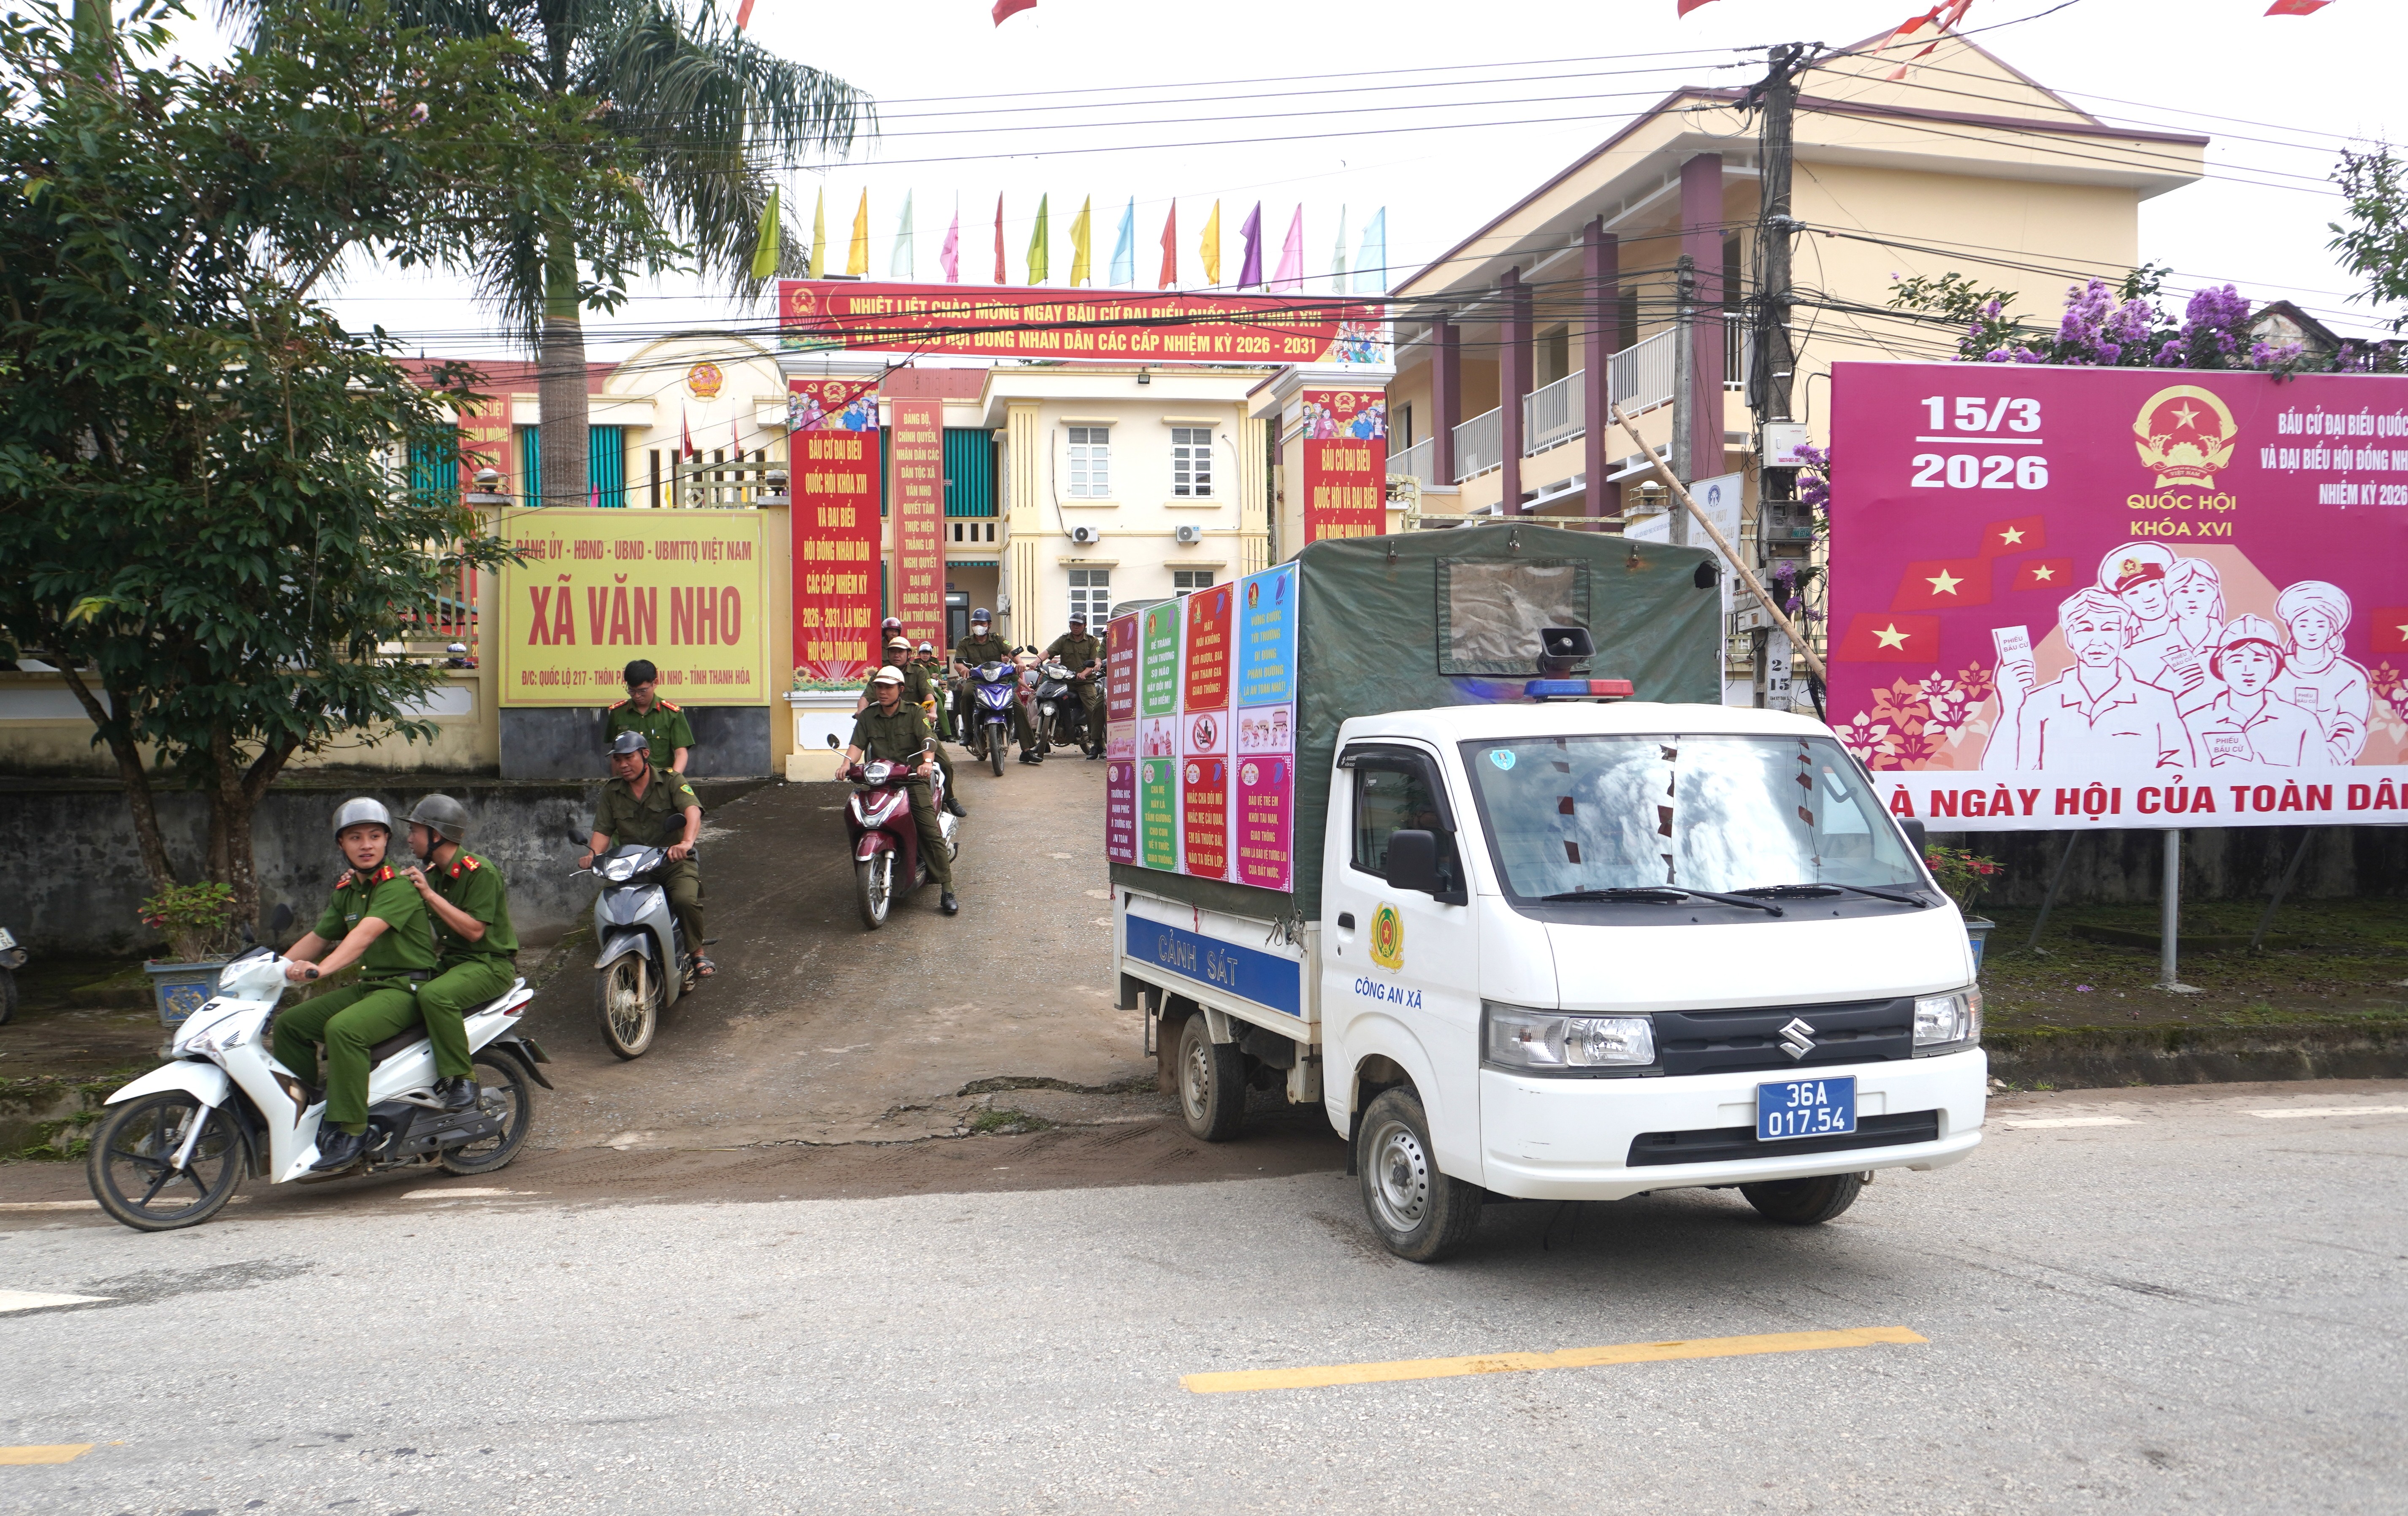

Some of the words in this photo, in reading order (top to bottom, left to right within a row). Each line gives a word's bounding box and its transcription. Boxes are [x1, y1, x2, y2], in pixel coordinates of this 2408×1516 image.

[932, 298, 971, 318] CHÀO
[976, 299, 1019, 320] MỪNG
[1019, 329, 1059, 349] NHÂN
[1065, 330, 1094, 350] DÂN
[1098, 331, 1127, 351] CÁC
[1131, 329, 1159, 352] CẤP
[1164, 332, 1210, 355] NHIỆM
[1215, 333, 1232, 353] KỲ
[1237, 336, 1270, 354] 2026
[1284, 337, 1316, 354] 2031
[904, 409, 920, 425] ĐẢNG
[1921, 396, 2042, 432] 15/3
[2278, 406, 2303, 434] BẦU
[2306, 404, 2325, 435] CỬ
[2324, 413, 2346, 440] ĐẠI
[2348, 406, 2375, 436] BIỂU
[2378, 408, 2408, 439] QUỐC
[486, 424, 508, 442] MỪNG
[898, 429, 916, 443] CHÍNH
[917, 427, 937, 444] QUYỀN,
[809, 432, 822, 459] BẦU
[824, 431, 834, 460] CỬ
[834, 439, 845, 464] ĐẠI
[847, 431, 862, 460] BIỂU
[1322, 441, 1334, 471] BẦU
[1335, 439, 1345, 471] CỬ
[1345, 449, 1355, 476] ĐẠI
[1357, 440, 1371, 472] BIỂU
[2261, 443, 2277, 469] VÀ
[2279, 448, 2300, 474] ĐẠI
[2302, 440, 2331, 470] BIỂU
[2333, 445, 2354, 475] HỘI
[2356, 442, 2389, 471] ĐỒNG
[805, 466, 823, 496] QUỐC
[824, 469, 836, 498] HỘI
[837, 469, 855, 494] KHÓA
[856, 474, 867, 494] XVI
[1911, 453, 2048, 490] 2026
[906, 483, 917, 496] VĂN
[919, 485, 931, 496] NHO
[1314, 478, 1330, 511] QUỐC
[1332, 482, 1342, 514] HỘI
[1343, 482, 1351, 509] VÀ
[1352, 486, 1362, 514] ĐẠI
[1364, 477, 1377, 509] BIỂU
[2127, 489, 2193, 510] QUỐC
[2199, 492, 2236, 513] HỘI
[2319, 480, 2359, 510] NHIỆM
[2361, 480, 2377, 505] KỲ
[2378, 484, 2408, 506] 2026
[818, 502, 826, 527] VÀ
[828, 507, 839, 532] ĐẠI
[840, 499, 856, 528] BIỂU
[2131, 516, 2192, 536] KHÓA
[2197, 522, 2232, 537] XVI
[516, 531, 546, 559] ĐẢNG
[549, 531, 563, 559] ỦY
[574, 540, 604, 559] HĐND
[615, 540, 644, 560] UBND
[655, 540, 698, 563] UBMTTQ
[701, 537, 724, 565] VIỆT
[727, 541, 752, 560] NAM
[804, 536, 815, 565] HỘI
[816, 534, 835, 561] ĐỒNG
[836, 537, 854, 561] NHÂN
[856, 537, 869, 561] DÂN
[807, 570, 820, 594] CÁC
[821, 567, 835, 594] CẤP
[836, 570, 857, 599] NHIỆM
[859, 570, 868, 594] KỲ
[910, 575, 919, 589] ĐẠI
[921, 573, 931, 588] HỘI
[528, 573, 576, 645] XÃ
[587, 573, 658, 645] VĂN
[670, 586, 742, 646] NHO
[803, 607, 819, 628] 2026
[825, 607, 843, 630] 2031,
[844, 603, 853, 628] LÀ
[853, 604, 871, 628] NGÀY
[1204, 619, 1214, 632] HÃY
[807, 637, 819, 666] HỘI
[820, 632, 834, 661] CỦA
[834, 637, 852, 661] TOÀN
[853, 637, 867, 661] DÂN
[1157, 637, 1171, 649] TRÁNH
[1205, 633, 1221, 645] KHÔNG
[2003, 635, 2023, 645] PHIẾU
[1214, 651, 1223, 662] BIA
[522, 670, 537, 686] Đ/C:
[539, 665, 560, 687] QUỐC
[562, 667, 571, 689] LỘ
[573, 671, 587, 685] 217
[594, 667, 614, 685] THÔN
[667, 670, 683, 685] NHO
[690, 664, 707, 684] TỈNH
[709, 670, 733, 684] THANH
[735, 667, 750, 684] HÓA
[1114, 668, 1119, 678] AN
[1120, 665, 1130, 677] TOÀN
[1151, 669, 1158, 679] SỌ
[1159, 666, 1169, 676] NÃO
[1192, 670, 1200, 681] KHI
[1200, 668, 1213, 680] THAM
[1213, 667, 1222, 677] GIA
[1192, 686, 1203, 696] GIAO
[1203, 682, 1221, 694] THÔNG!
[1769, 678, 1790, 691] 15
[1149, 694, 1157, 706] BẢO
[2216, 736, 2239, 744] PHIẾU
[1198, 793, 1206, 804] CHA
[1249, 791, 1257, 806] BẢO
[1271, 796, 1278, 806] EM
[1930, 780, 2042, 818] NGÀY
[2055, 781, 2122, 822] HỘI
[2137, 775, 2216, 814] CỦA
[2230, 779, 2332, 812] TOÀN
[1251, 830, 1260, 841] GIAO
[1261, 830, 1275, 842] THÔNG
[1159, 929, 1196, 972] CẢNH
[1207, 948, 1238, 986] SÁT
[1355, 976, 1385, 1000] CÔNG
[1387, 987, 1403, 1005] AN
[1406, 989, 1422, 1010] XÃ
[1786, 1082, 1828, 1108] 36A
[1769, 1106, 1845, 1136] 017.54
